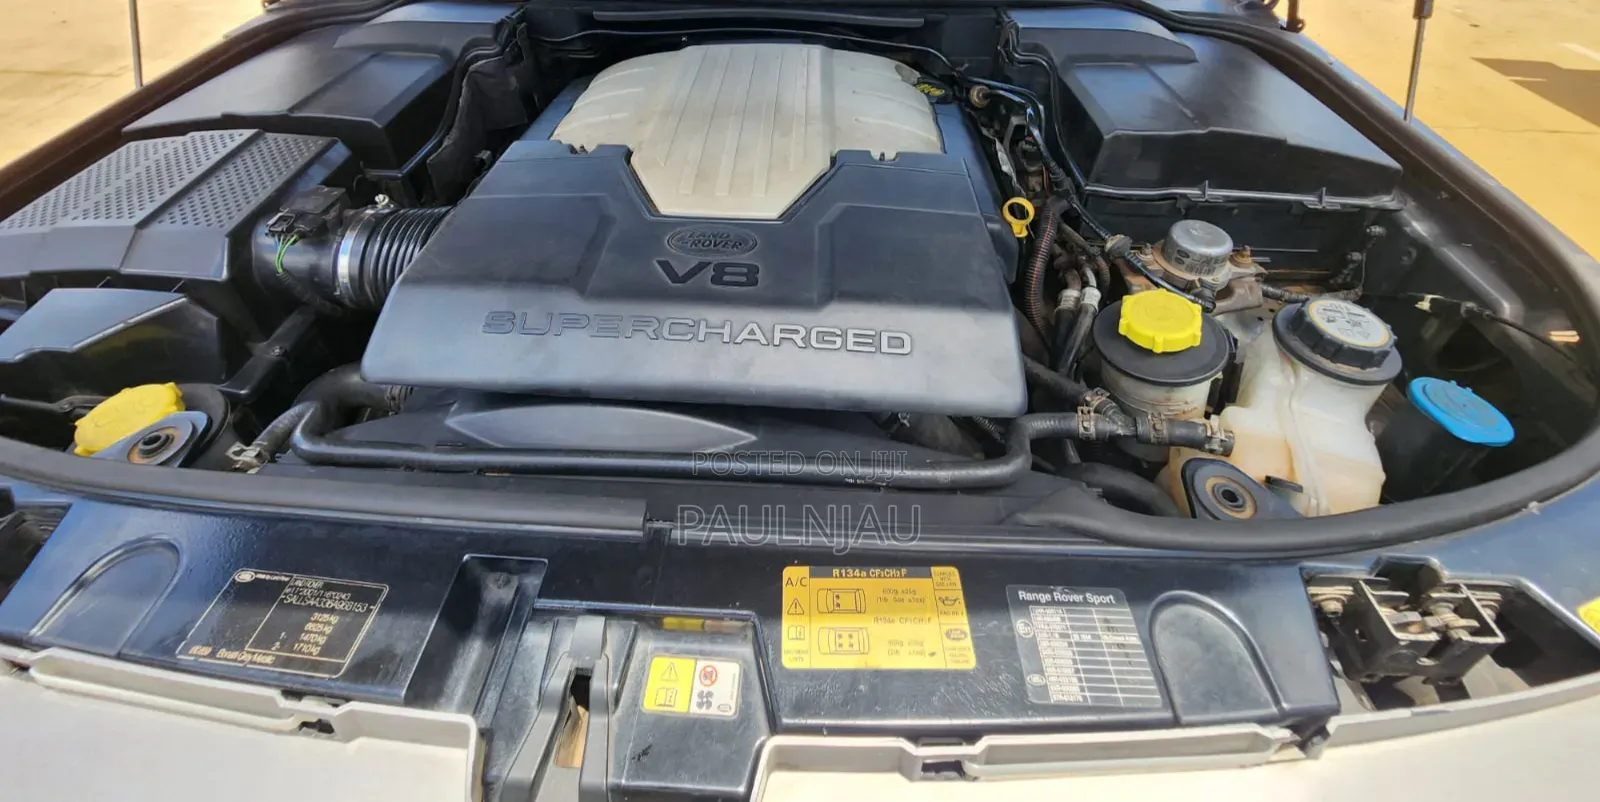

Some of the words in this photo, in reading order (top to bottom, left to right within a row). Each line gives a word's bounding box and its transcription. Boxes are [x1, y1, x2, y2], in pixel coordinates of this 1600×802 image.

[687, 231, 731, 239] LAND
[688, 239, 743, 250] ROVER
[655, 259, 760, 287] V8
[482, 310, 912, 355] SUPERCHARGED
[832, 568, 867, 578] R134a
[785, 577, 808, 588] A/C
[1018, 590, 1051, 603] Range
[1054, 592, 1084, 602] Rover
[1086, 593, 1116, 605] Sport
[293, 643, 311, 652] 1710
